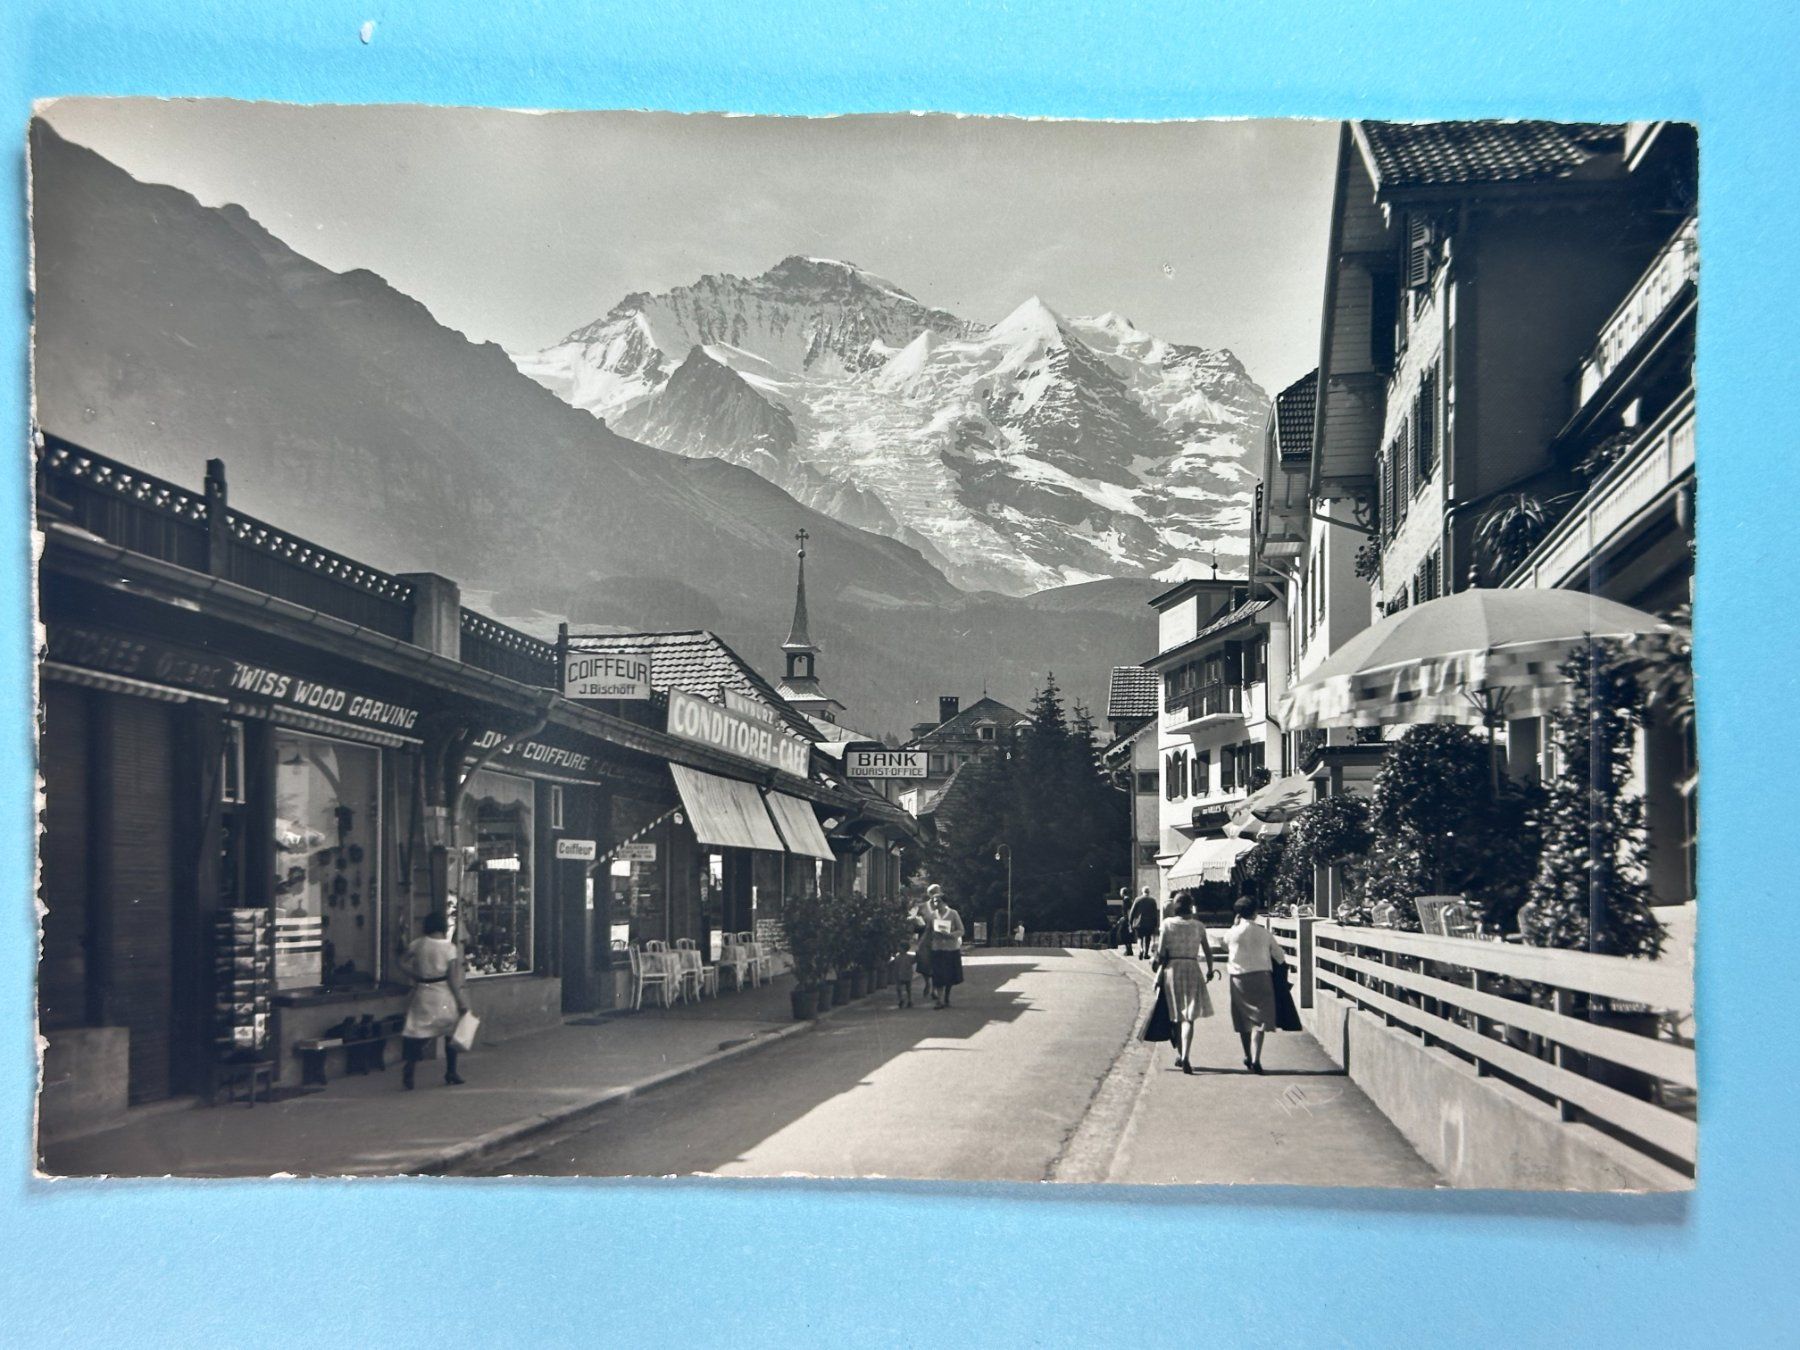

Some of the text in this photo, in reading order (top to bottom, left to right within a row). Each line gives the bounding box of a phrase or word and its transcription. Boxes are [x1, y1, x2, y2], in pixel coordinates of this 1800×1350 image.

[568, 658, 647, 684] COIFFEUR
[293, 680, 346, 711] WOOD
[523, 741, 591, 771] COIFFURE
[858, 753, 916, 767] BANK
[558, 842, 593, 856] Coiffeur
